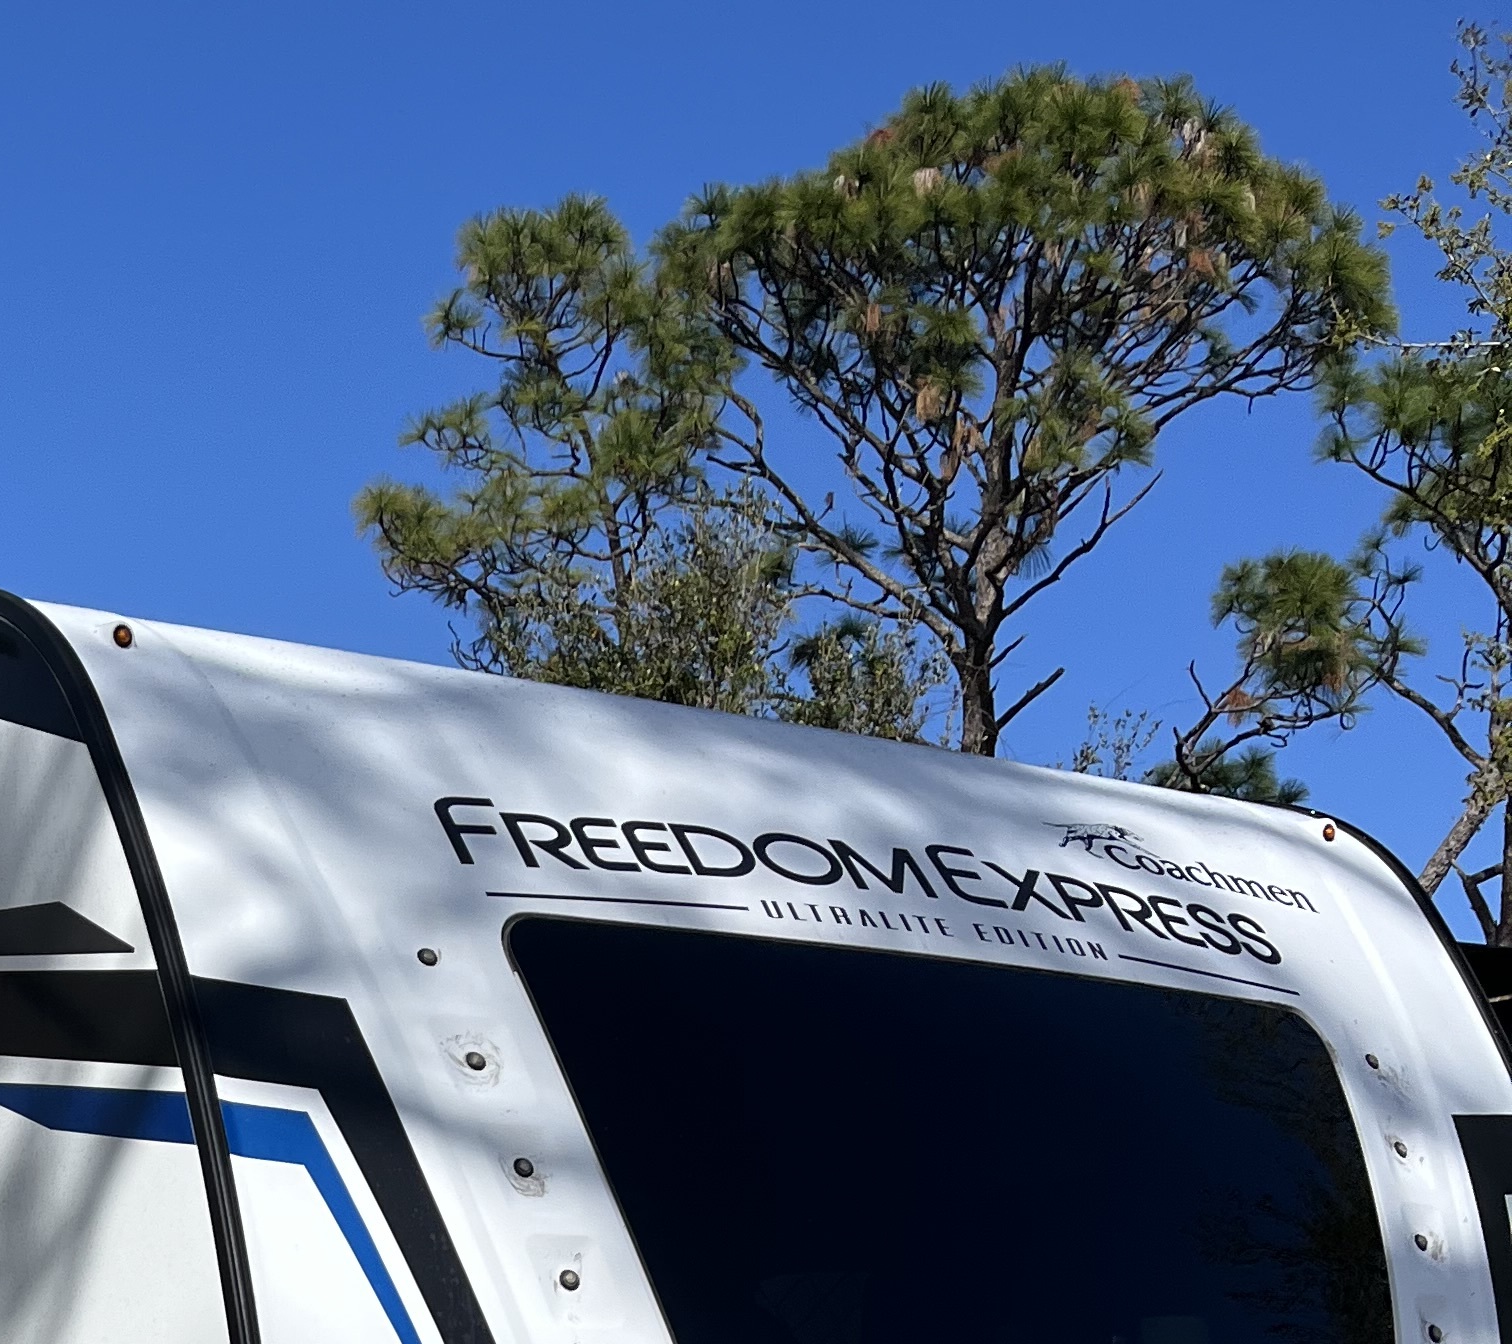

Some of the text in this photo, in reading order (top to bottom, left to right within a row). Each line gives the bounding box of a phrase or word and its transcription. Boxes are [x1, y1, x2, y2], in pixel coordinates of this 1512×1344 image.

[1103, 844, 1320, 914] Coachmen
[760, 899, 1110, 961] ULTRALITE EDITION
